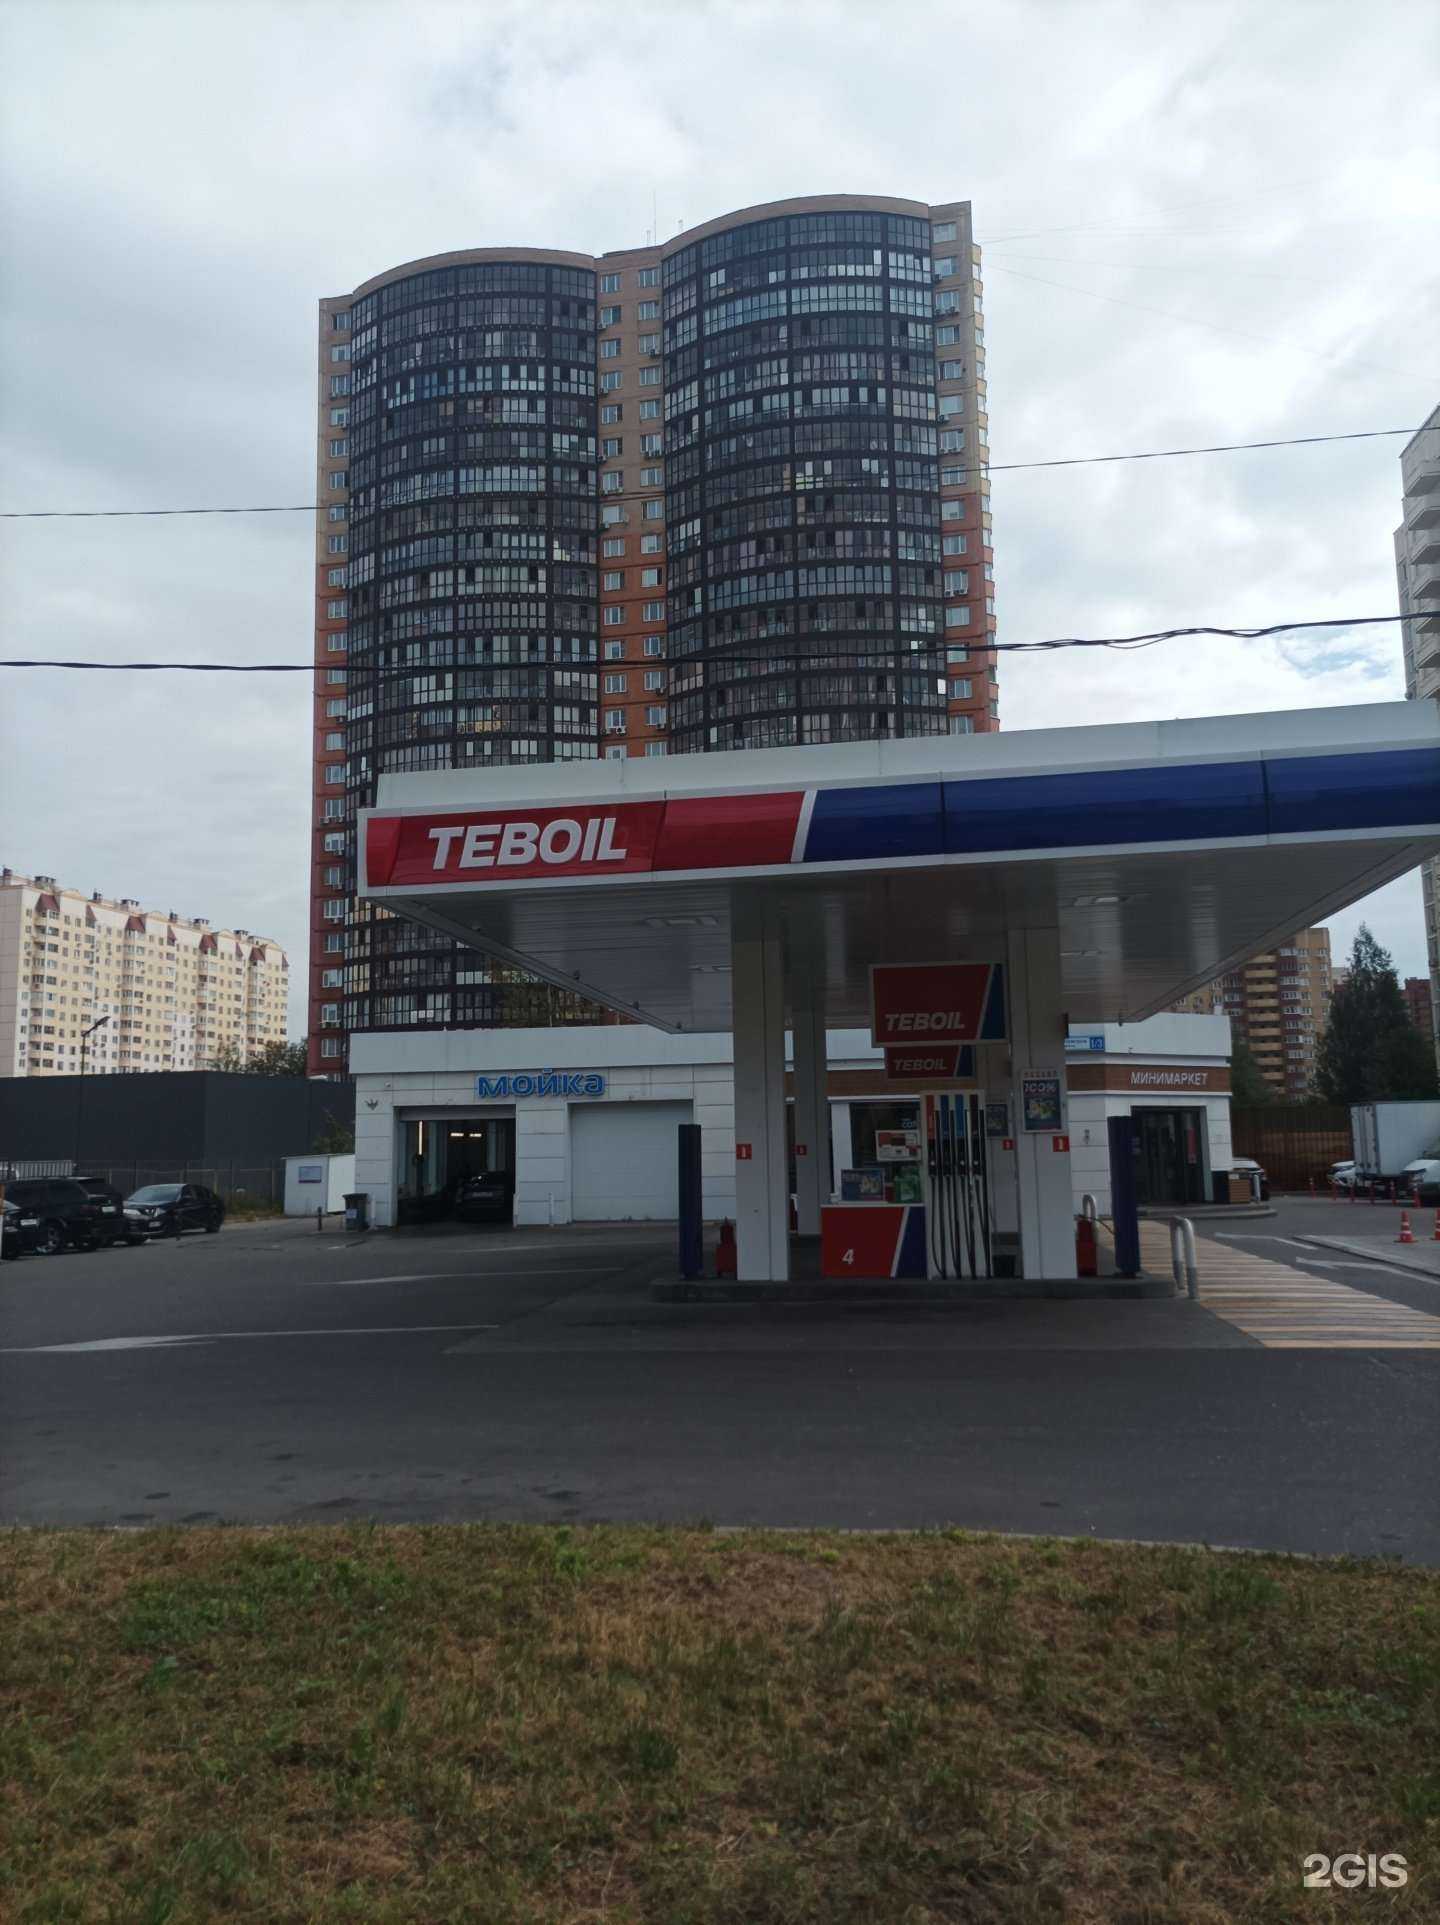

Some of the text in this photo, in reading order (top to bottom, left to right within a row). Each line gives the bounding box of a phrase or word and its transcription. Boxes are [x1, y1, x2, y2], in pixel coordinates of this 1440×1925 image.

[428, 817, 628, 870] TEBOIL
[885, 1011, 965, 1031] TEBOIL
[892, 1058, 948, 1072] TEBOIL
[1130, 1071, 1209, 1086] МИНИМАРКЕТ
[842, 1248, 854, 1265] 4
